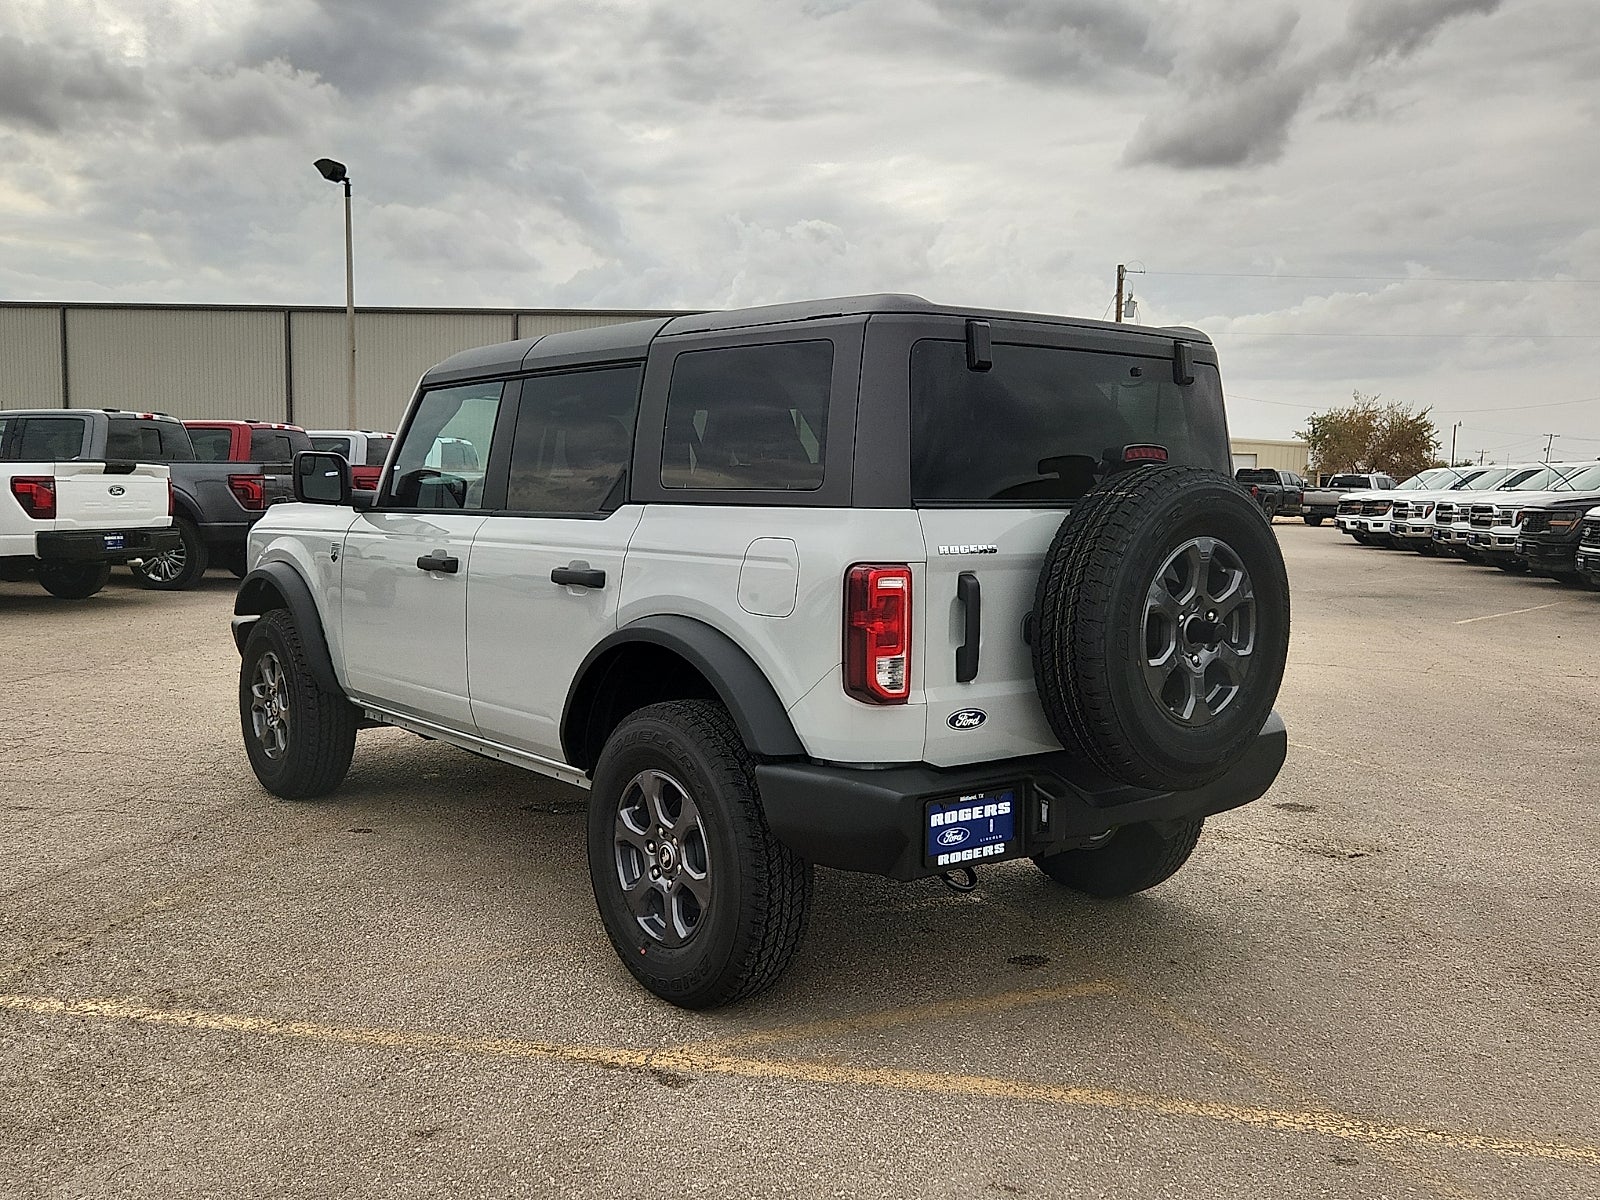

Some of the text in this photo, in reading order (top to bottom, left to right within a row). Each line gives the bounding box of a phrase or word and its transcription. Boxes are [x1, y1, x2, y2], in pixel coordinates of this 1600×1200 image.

[938, 544, 997, 555] ROGERS
[955, 712, 980, 727] Ford
[930, 801, 1011, 827] ROGERS
[943, 830, 964, 844] Ford
[937, 843, 1005, 866] ROGERS
